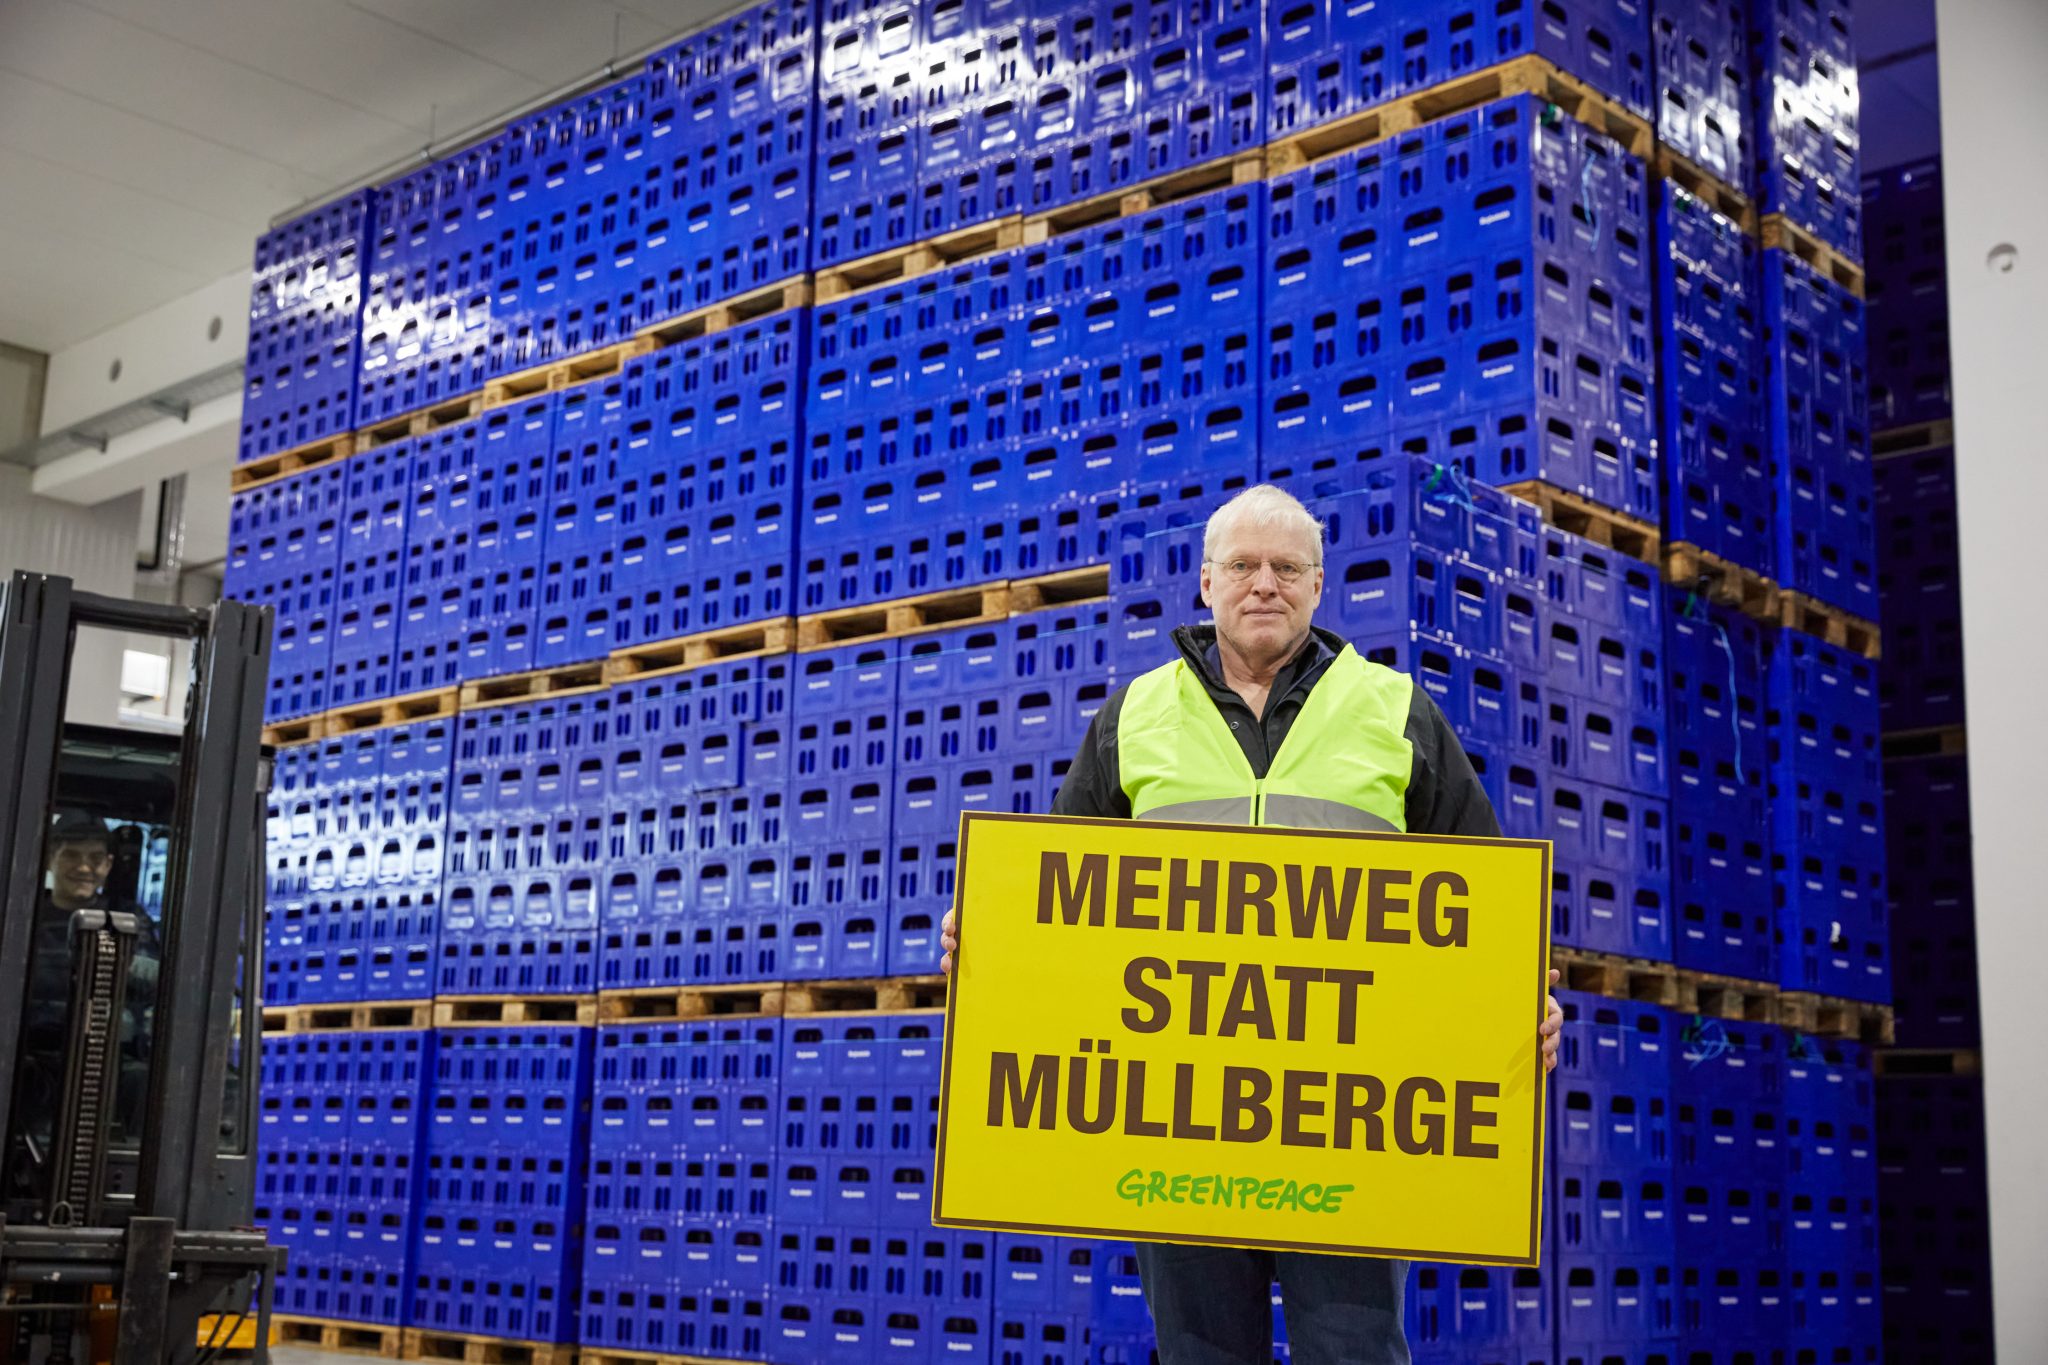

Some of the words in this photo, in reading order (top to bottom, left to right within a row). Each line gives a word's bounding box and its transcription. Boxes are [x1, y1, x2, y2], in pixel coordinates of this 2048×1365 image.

[1037, 851, 1469, 948] MEHRWEG
[1121, 956, 1374, 1044] STATT
[987, 1038, 1500, 1159] MÜLLBERGE
[1117, 1169, 1354, 1213] GREENPEACE
